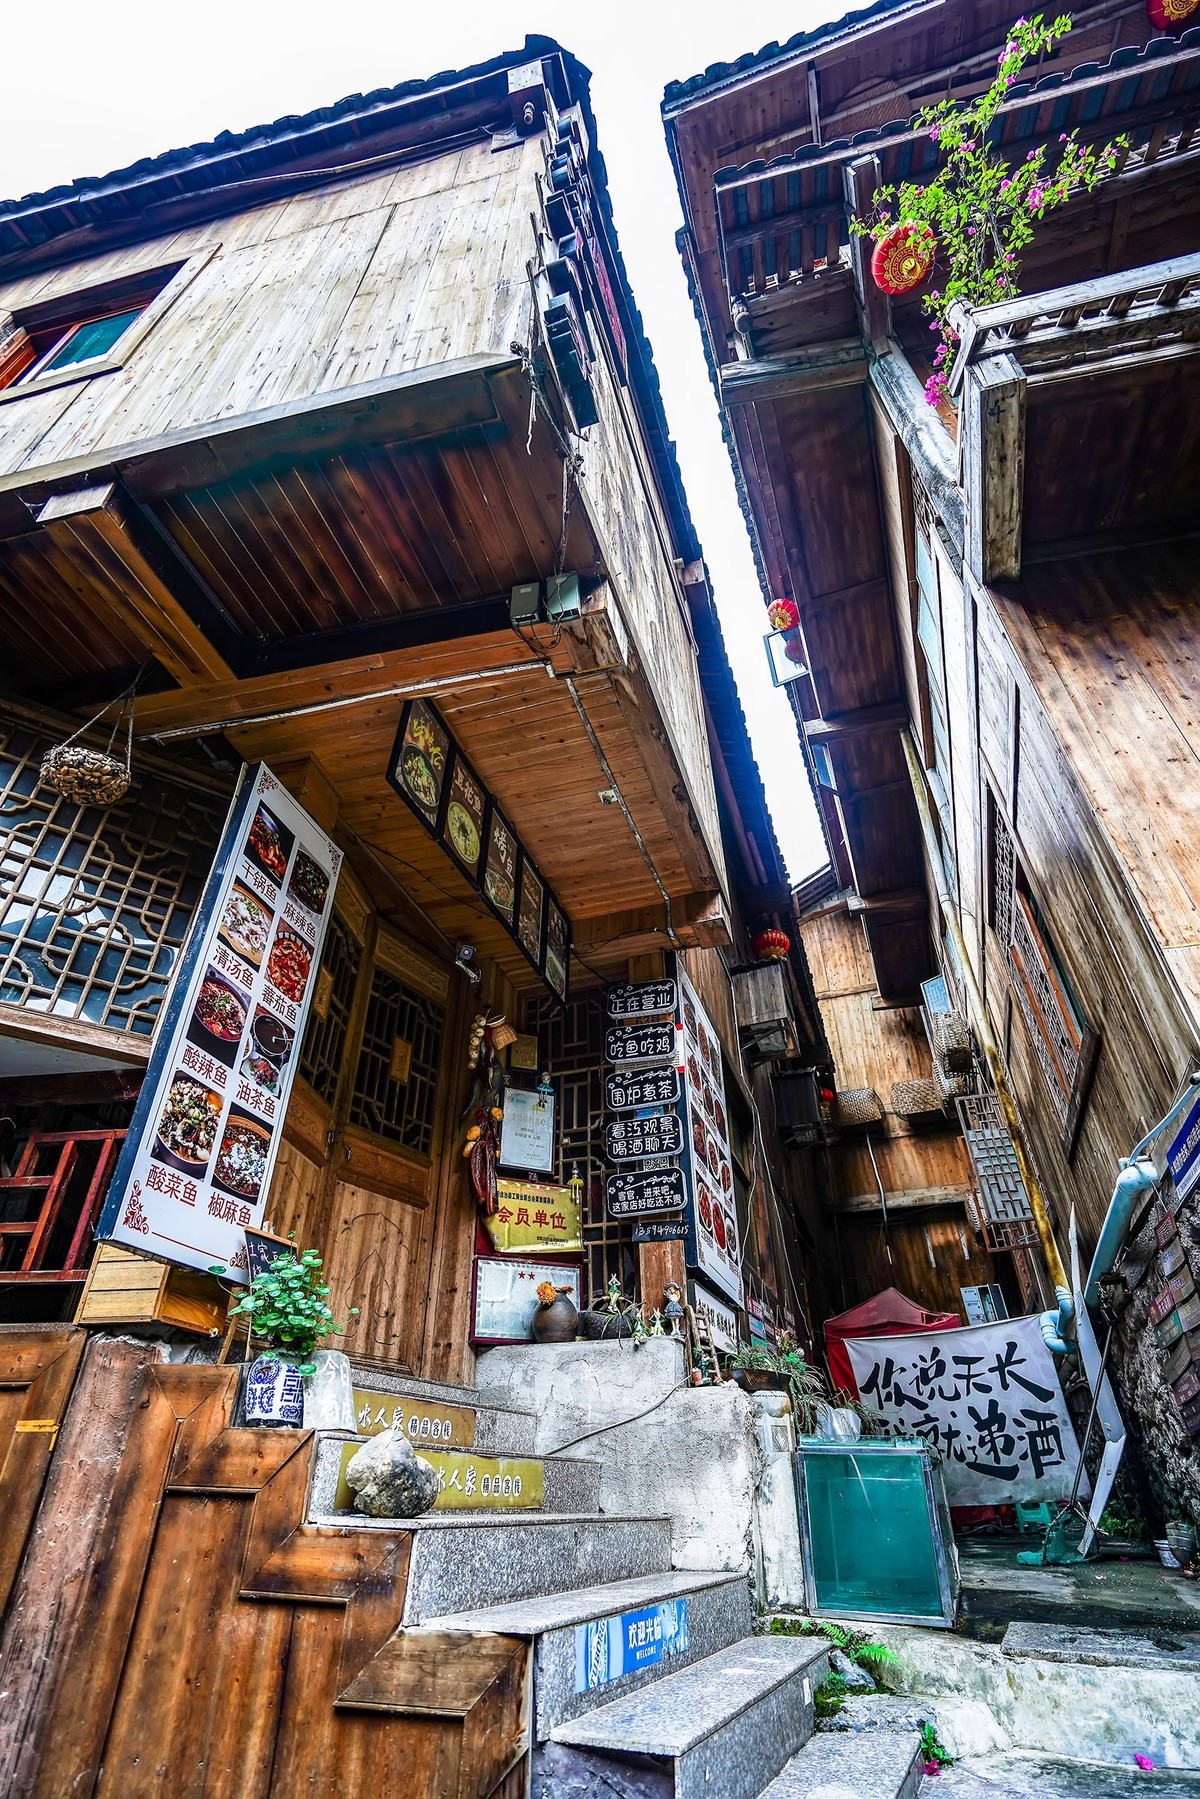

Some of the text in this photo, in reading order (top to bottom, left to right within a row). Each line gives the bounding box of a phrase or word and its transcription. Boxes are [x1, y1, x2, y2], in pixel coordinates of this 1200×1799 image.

[494, 826, 514, 882] 烤鱼
[242, 860, 277, 904] 干锅鱼
[283, 902, 316, 941] 麻辣鱼
[213, 944, 254, 990] 清汤鱼
[262, 984, 297, 1024] 蕃茄鱼
[612, 992, 671, 1013] 正在营业
[610, 1036, 670, 1057] 吃鱼吃鸡
[182, 1044, 228, 1089] 酸辣鱼
[236, 1080, 276, 1119] 油茶鱼
[612, 1080, 672, 1106] 围炉煮茶
[612, 1117, 673, 1138] 看江观景
[613, 1135, 676, 1155] 喝酒聊天
[146, 1164, 198, 1207] 酸菜鱼
[612, 1194, 682, 1212] 这家店好吃还不贵
[208, 1192, 251, 1227] 椒麻鱼
[496, 1205, 568, 1230] 会员单位
[859, 1341, 1055, 1411] 你说天长
[628, 1616, 661, 1650] 欢迎光临
[636, 1645, 657, 1660] WELCOME
